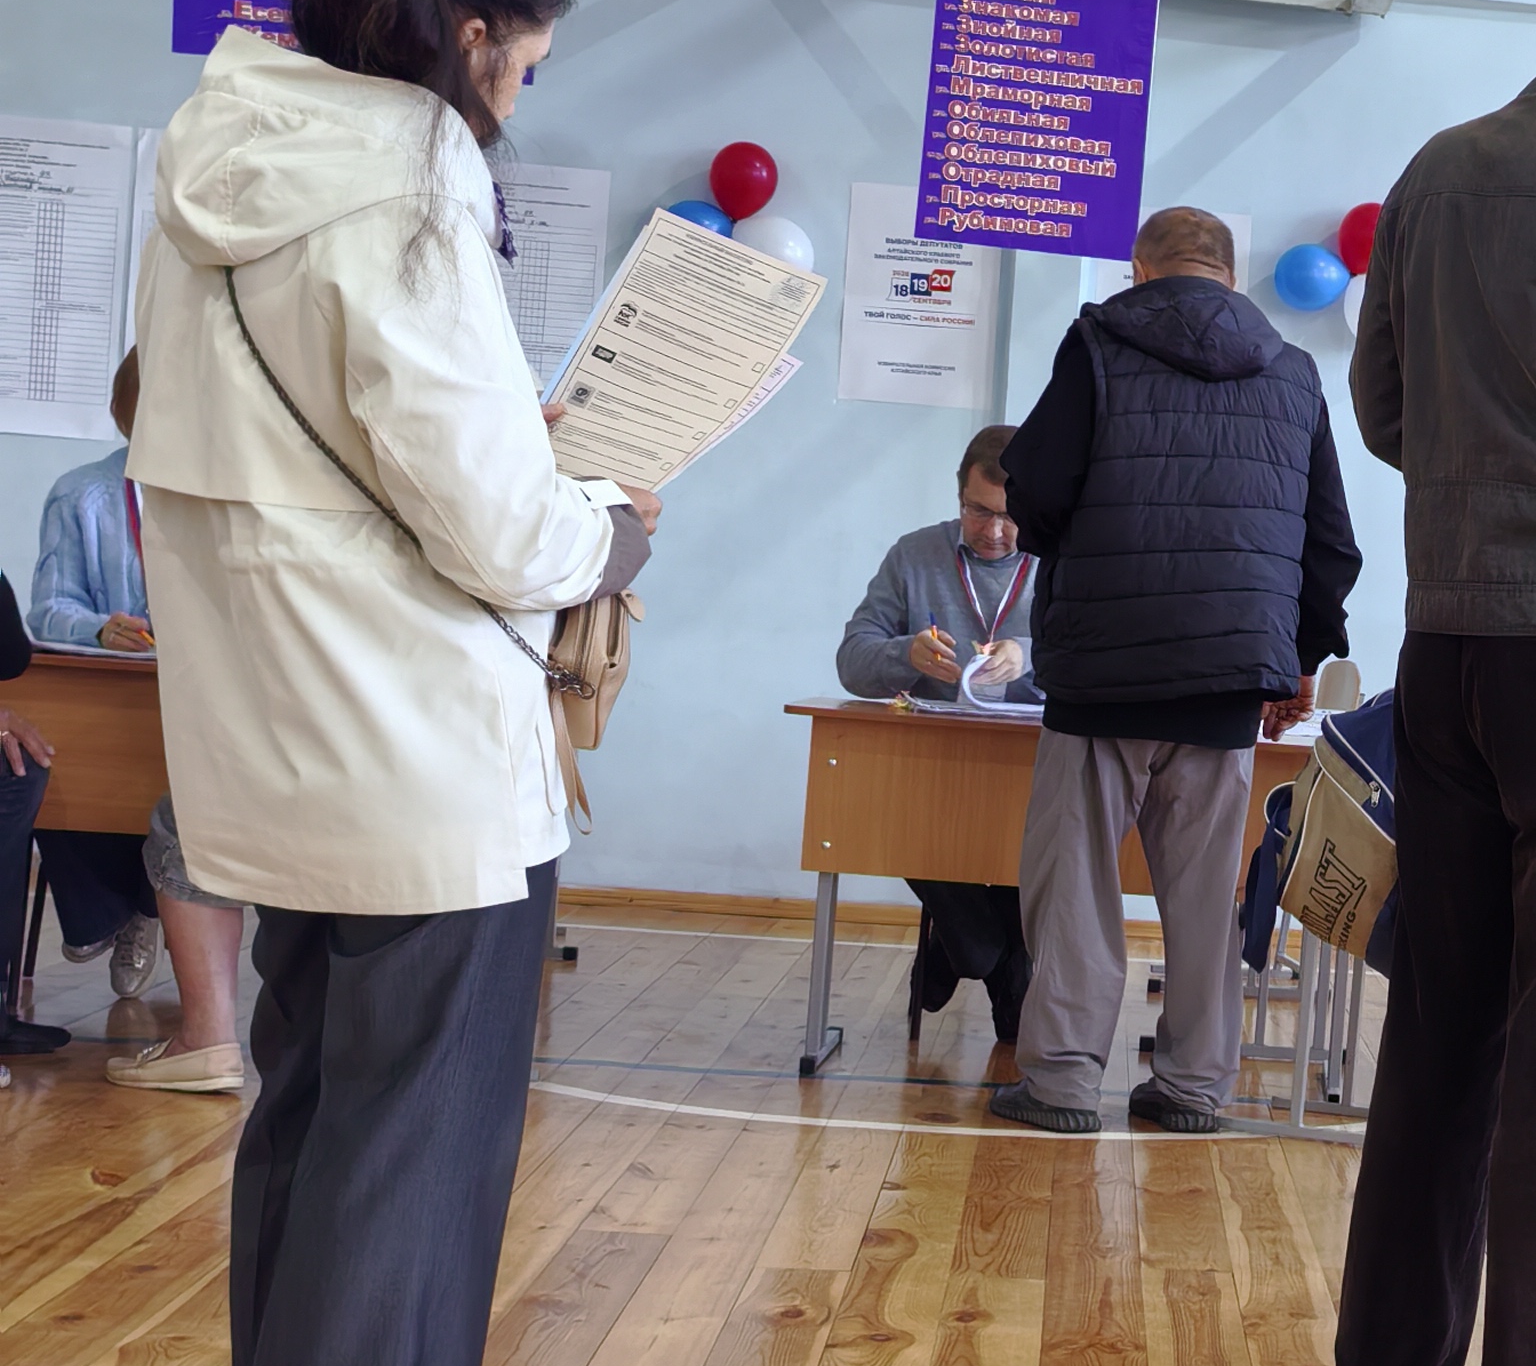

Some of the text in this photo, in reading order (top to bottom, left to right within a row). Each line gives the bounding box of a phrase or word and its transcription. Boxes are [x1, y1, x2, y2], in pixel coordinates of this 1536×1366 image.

[956, 14, 1062, 44] Знойная
[954, 33, 1095, 69] Золотистая
[950, 54, 1144, 95] Лиственничная
[950, 74, 1092, 112] Мраморная
[947, 99, 1070, 131] Обильная
[946, 119, 1111, 157] Облепиховая
[944, 141, 1117, 178] Облепиховый
[942, 161, 1061, 191] Отрадная
[941, 184, 1087, 217] Просторная
[938, 206, 1072, 238] Рубиновая
[885, 237, 963, 250] ВЫБОРЫ ДЕПУТАТОВ
[893, 274, 951, 297] 18 19 20
[864, 310, 885, 319] ТВОЙ
[886, 312, 912, 320] ГОЛОС
